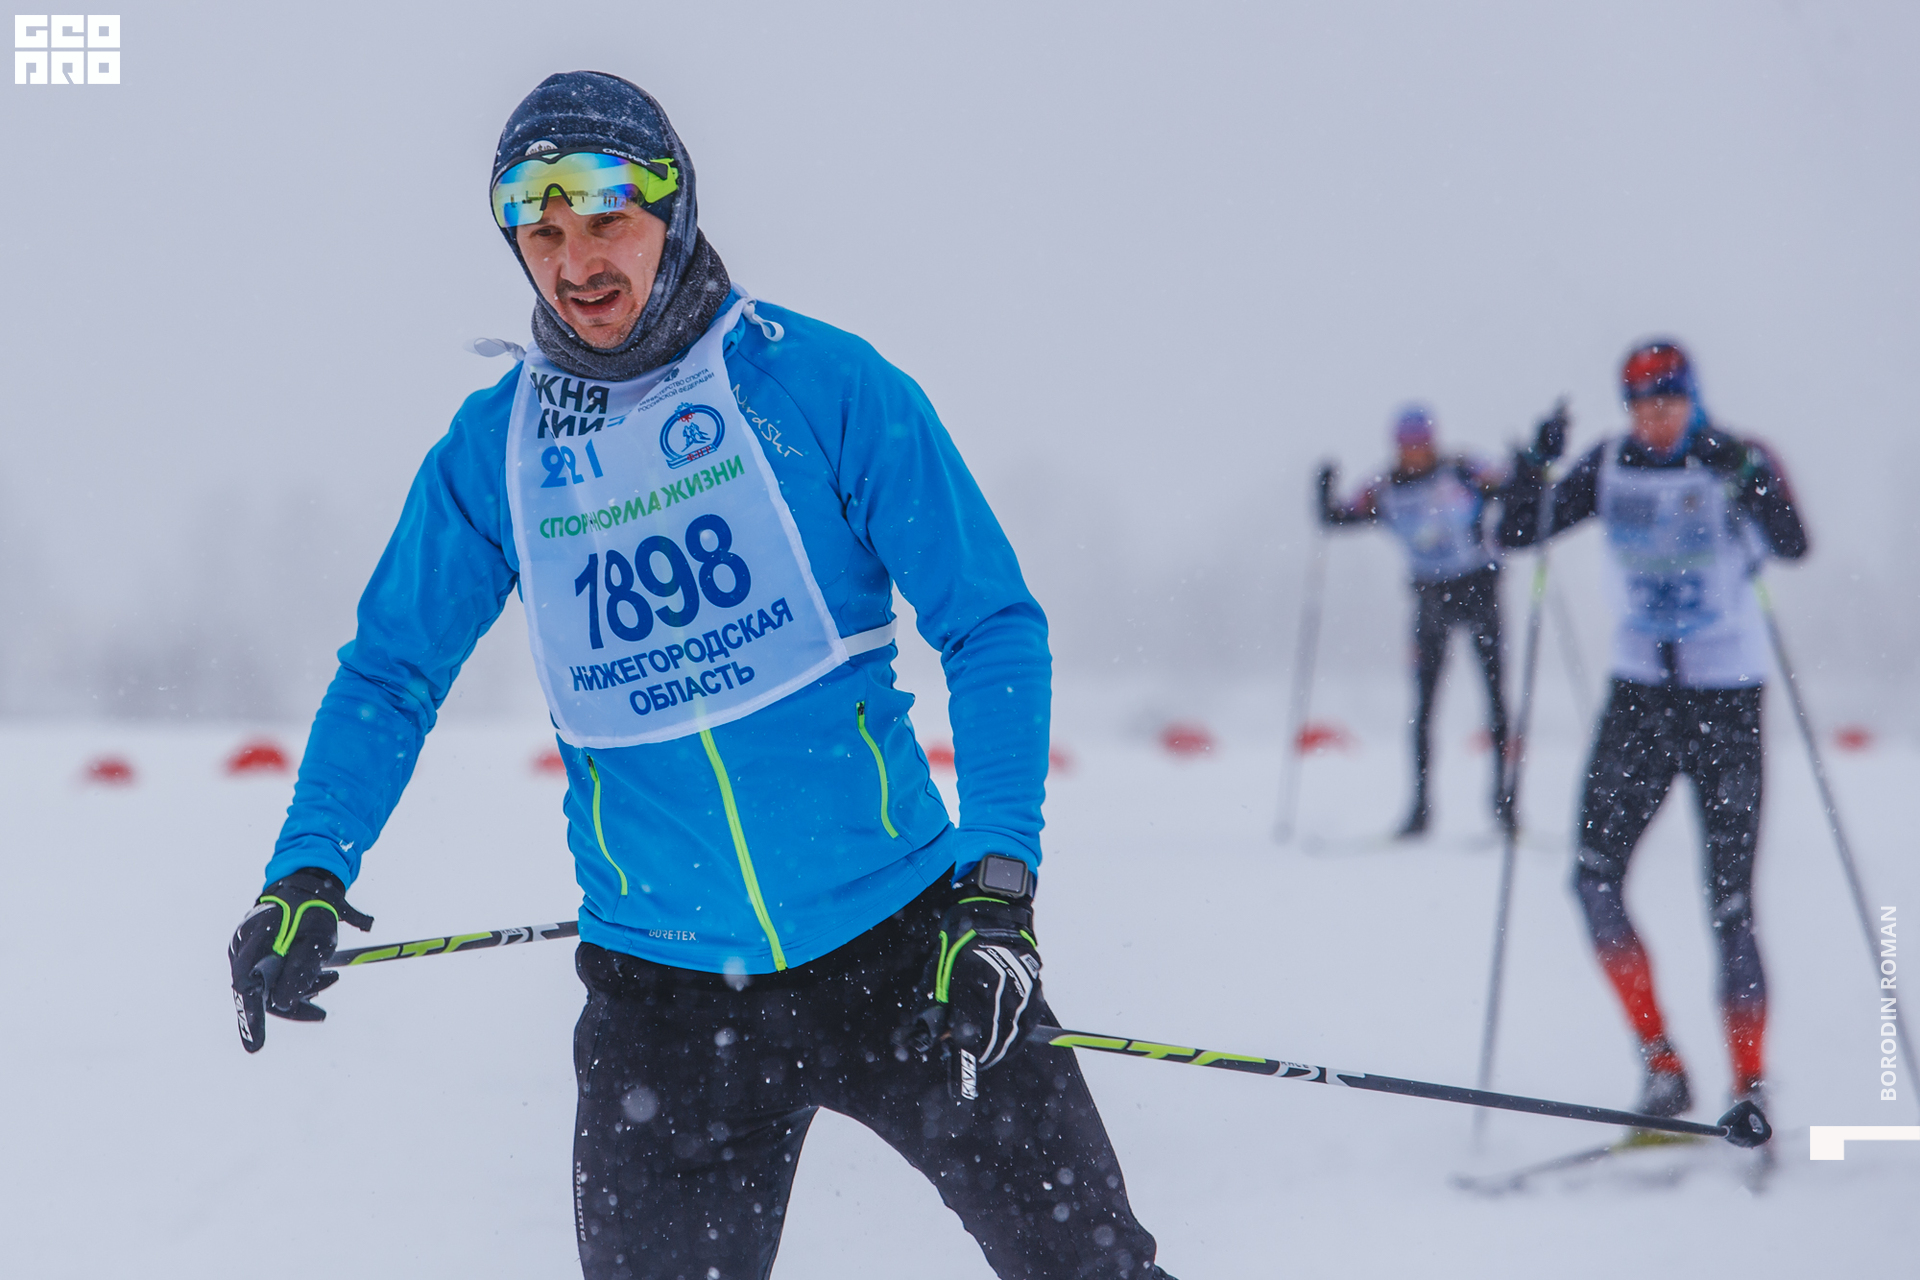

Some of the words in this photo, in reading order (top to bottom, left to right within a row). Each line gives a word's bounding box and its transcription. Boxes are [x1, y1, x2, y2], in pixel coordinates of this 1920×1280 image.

[678, 371, 716, 395] ФЕДЕРАЦИИ
[685, 368, 709, 385] СПОРТА
[660, 454, 746, 508] ЖИЗНИ
[574, 513, 752, 650] 1898
[569, 596, 794, 692] НИЖЕГОРОДСКАЯ
[629, 660, 756, 716] ОБЛАСТЬ
[648, 928, 698, 941] GORE-TEX
